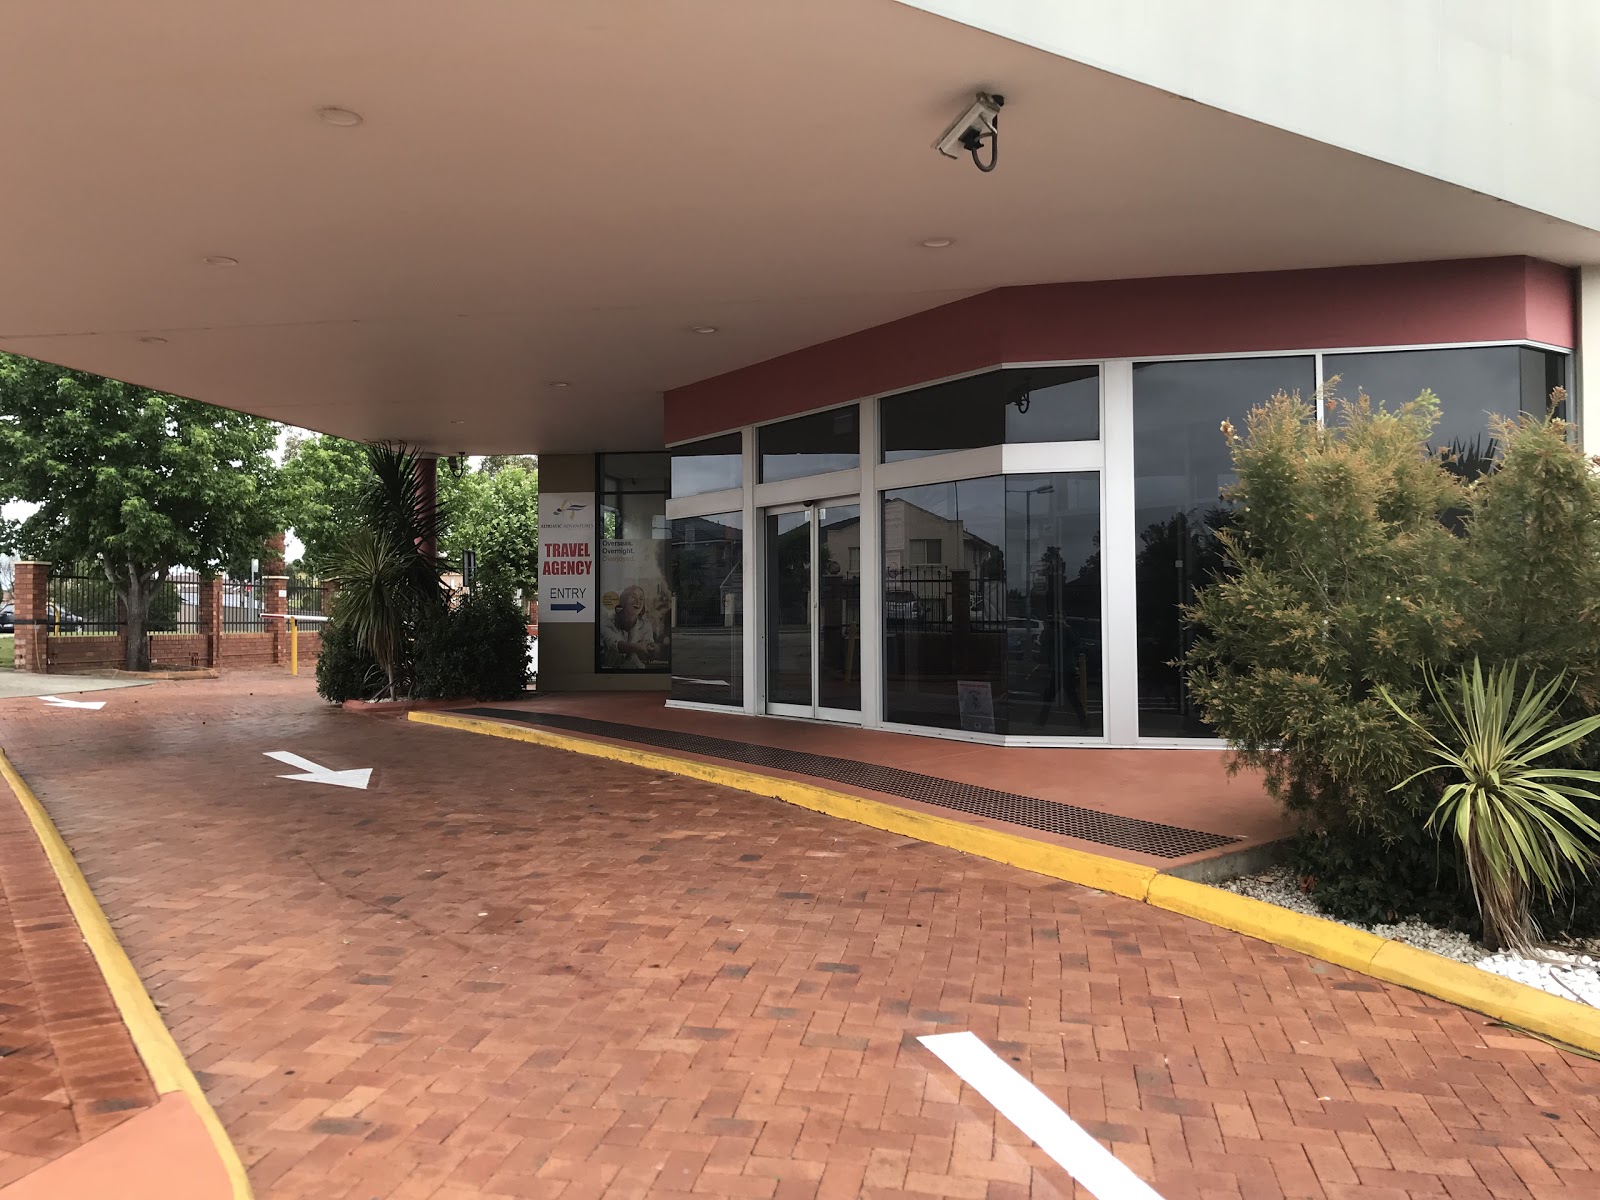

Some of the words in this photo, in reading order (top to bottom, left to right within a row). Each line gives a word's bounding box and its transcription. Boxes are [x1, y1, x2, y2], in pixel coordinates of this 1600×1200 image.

[545, 543, 590, 557] TRAVEL
[543, 561, 592, 575] AGENCY
[550, 588, 586, 598] ENTRY
